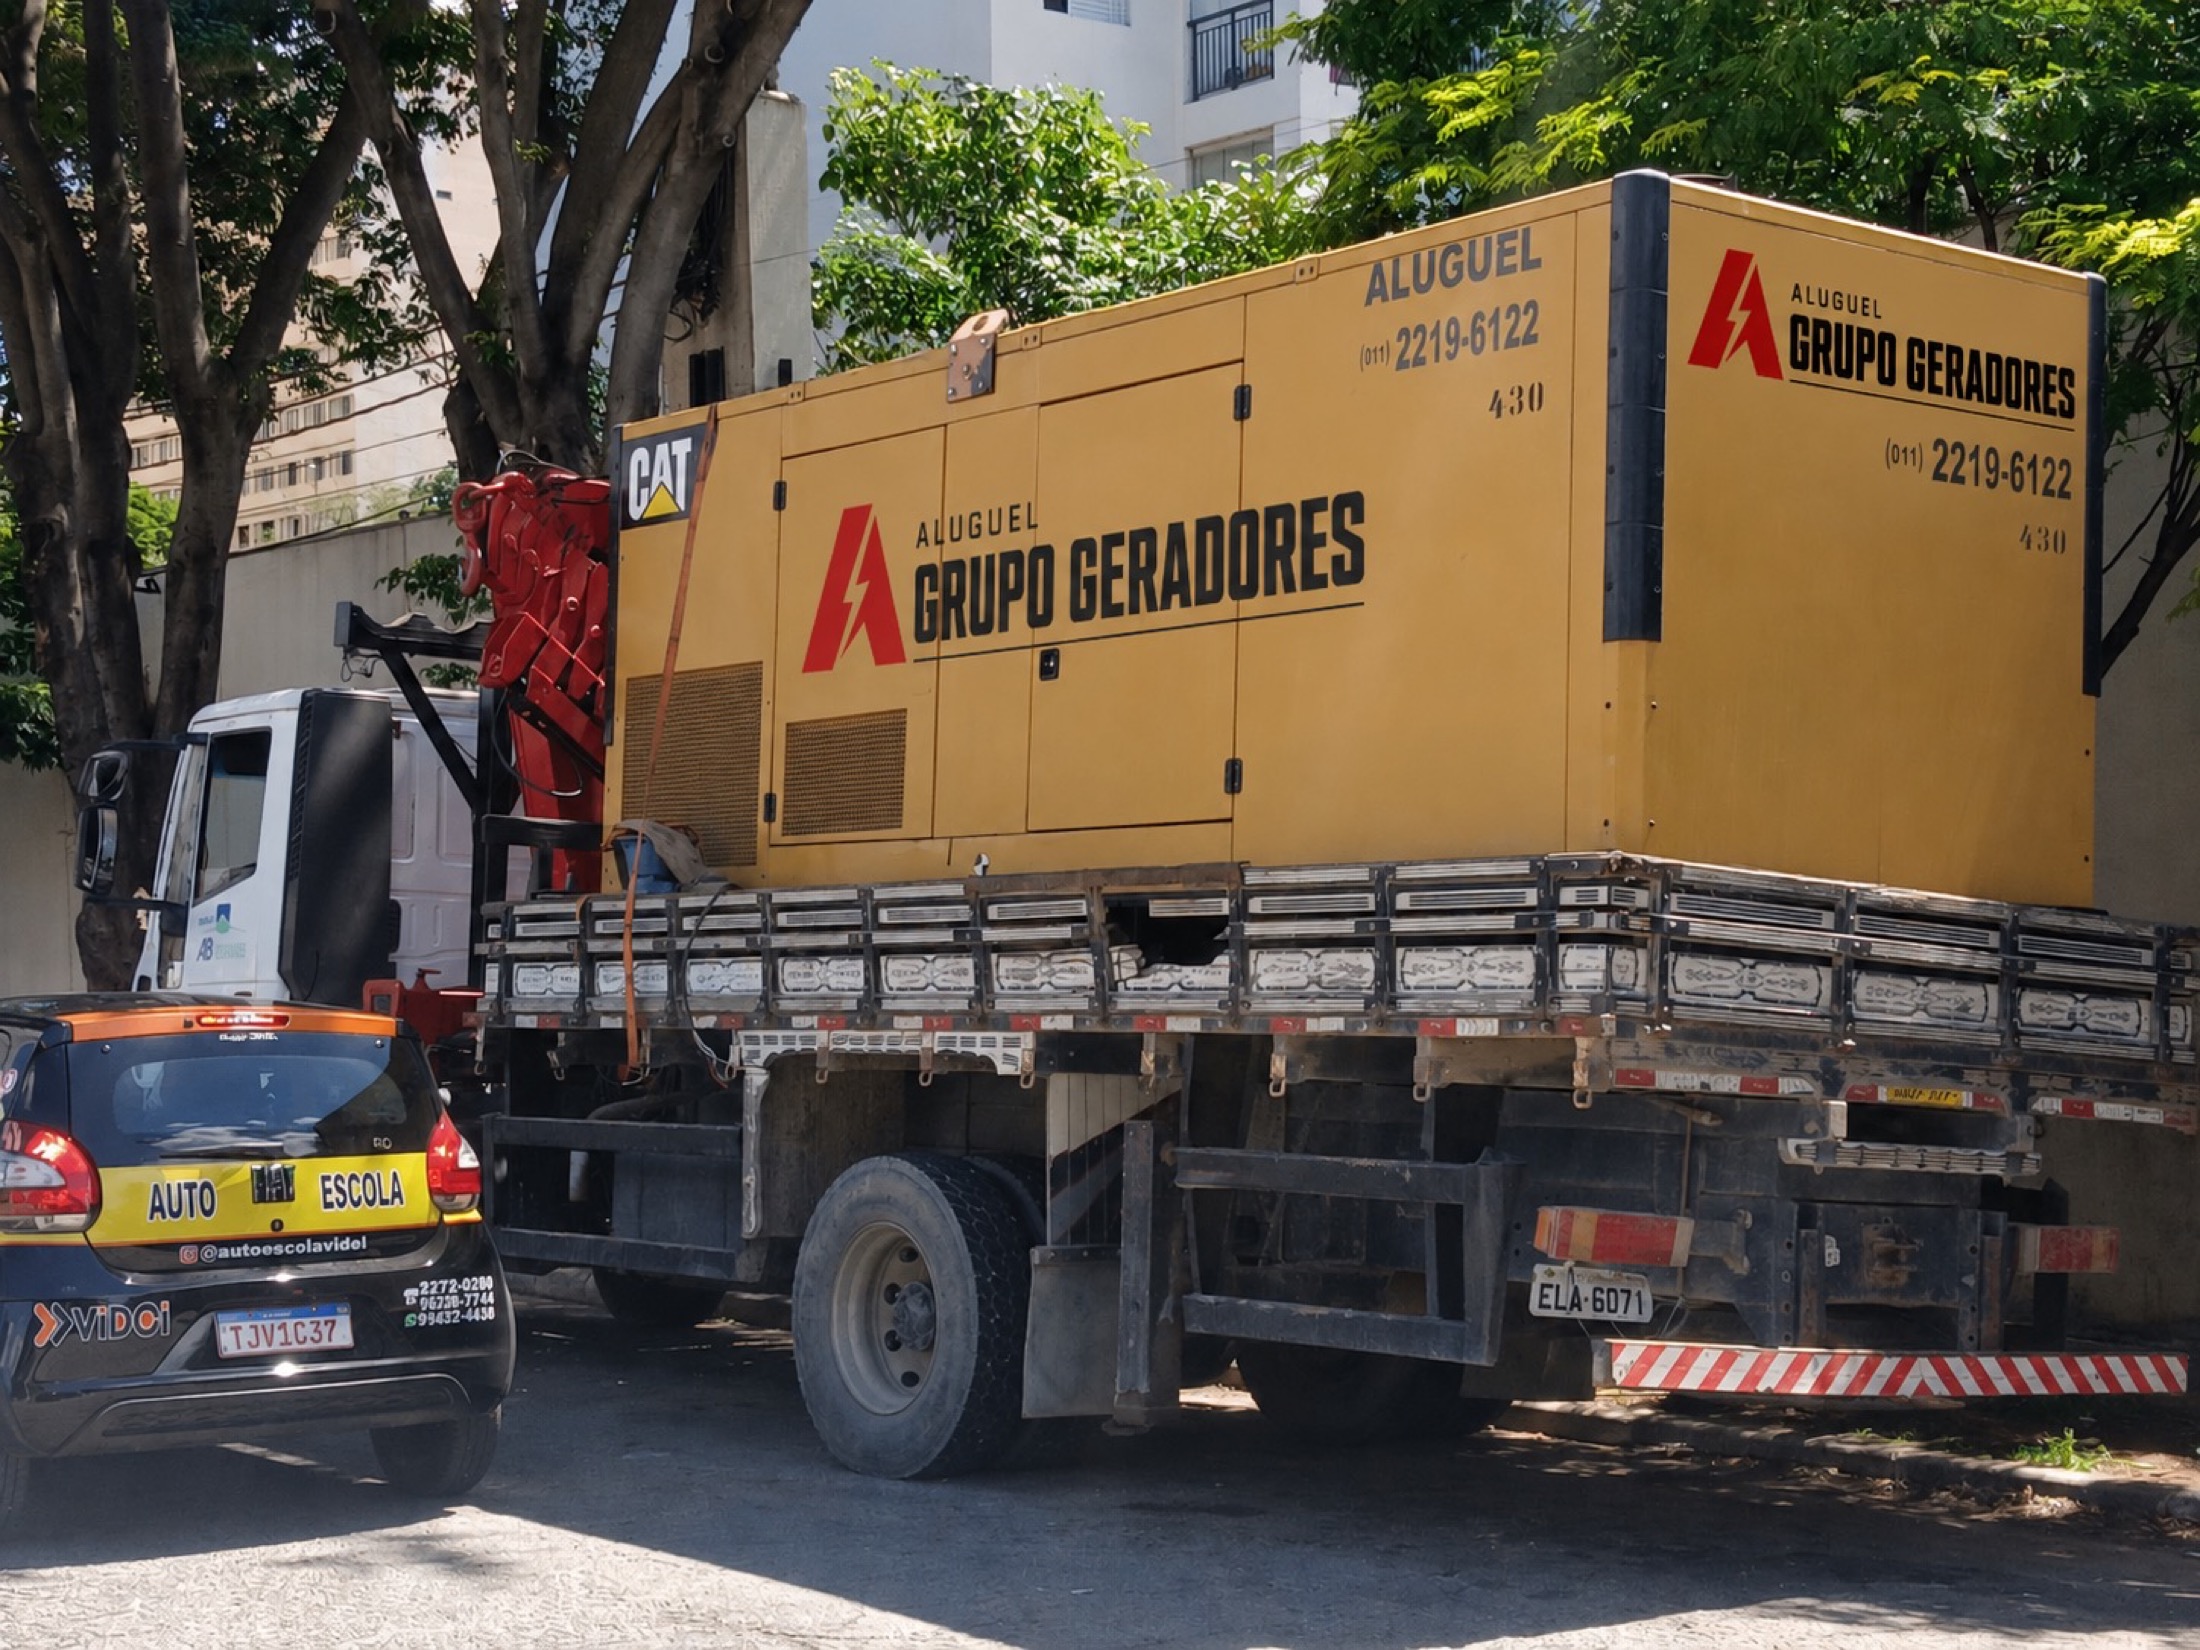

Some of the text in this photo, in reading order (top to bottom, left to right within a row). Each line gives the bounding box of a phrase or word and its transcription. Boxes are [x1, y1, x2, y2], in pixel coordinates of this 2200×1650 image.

[1364, 226, 1542, 307] ALUGUEL
[1790, 283, 1883, 319] ALUGUEL
[1359, 299, 1540, 372] (011) 2219-6122
[1789, 313, 2075, 420] GRUPO GERADORES
[1488, 382, 1544, 419] 430
[629, 437, 692, 520] CAT
[1885, 438, 2072, 500] (011) 2219-6122
[916, 501, 1038, 548] ALUGUEL
[2019, 524, 2067, 555] 430
[914, 490, 1365, 644] GRUPO GERADORES
[148, 1171, 405, 1222] AUTO ESCOLA
[230, 1318, 337, 1350] TJV1C37
